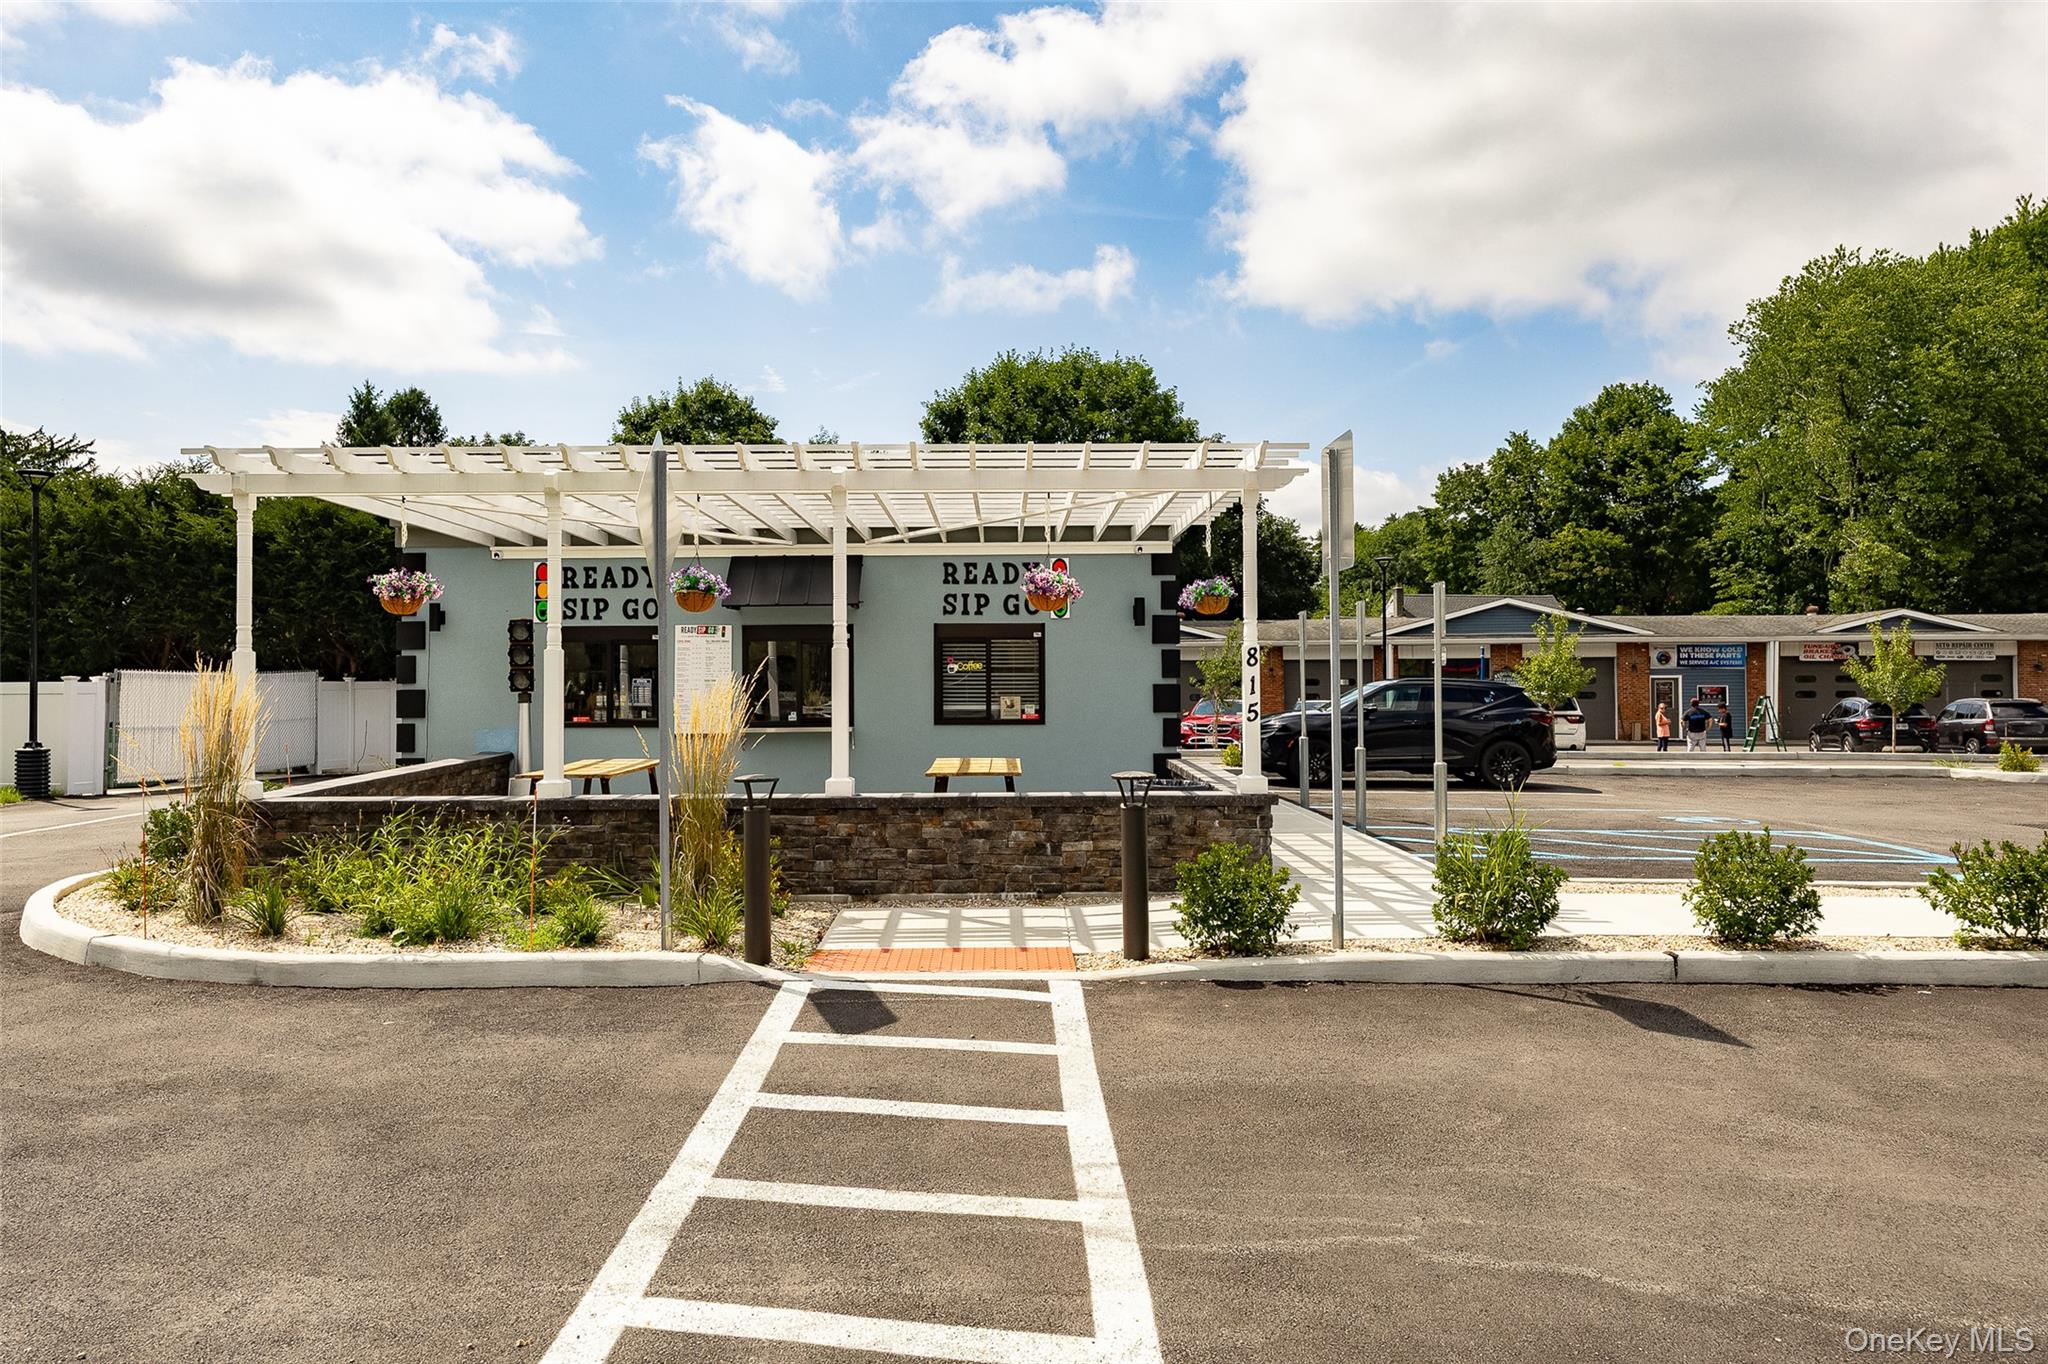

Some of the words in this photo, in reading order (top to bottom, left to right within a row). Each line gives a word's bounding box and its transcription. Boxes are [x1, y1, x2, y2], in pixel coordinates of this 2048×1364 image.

[561, 566, 654, 589] READY
[562, 598, 610, 620] SIP
[622, 598, 659, 620] GO
[942, 593, 991, 616] SIP
[956, 661, 984, 672] Coffee
[1246, 647, 1259, 722] 815
